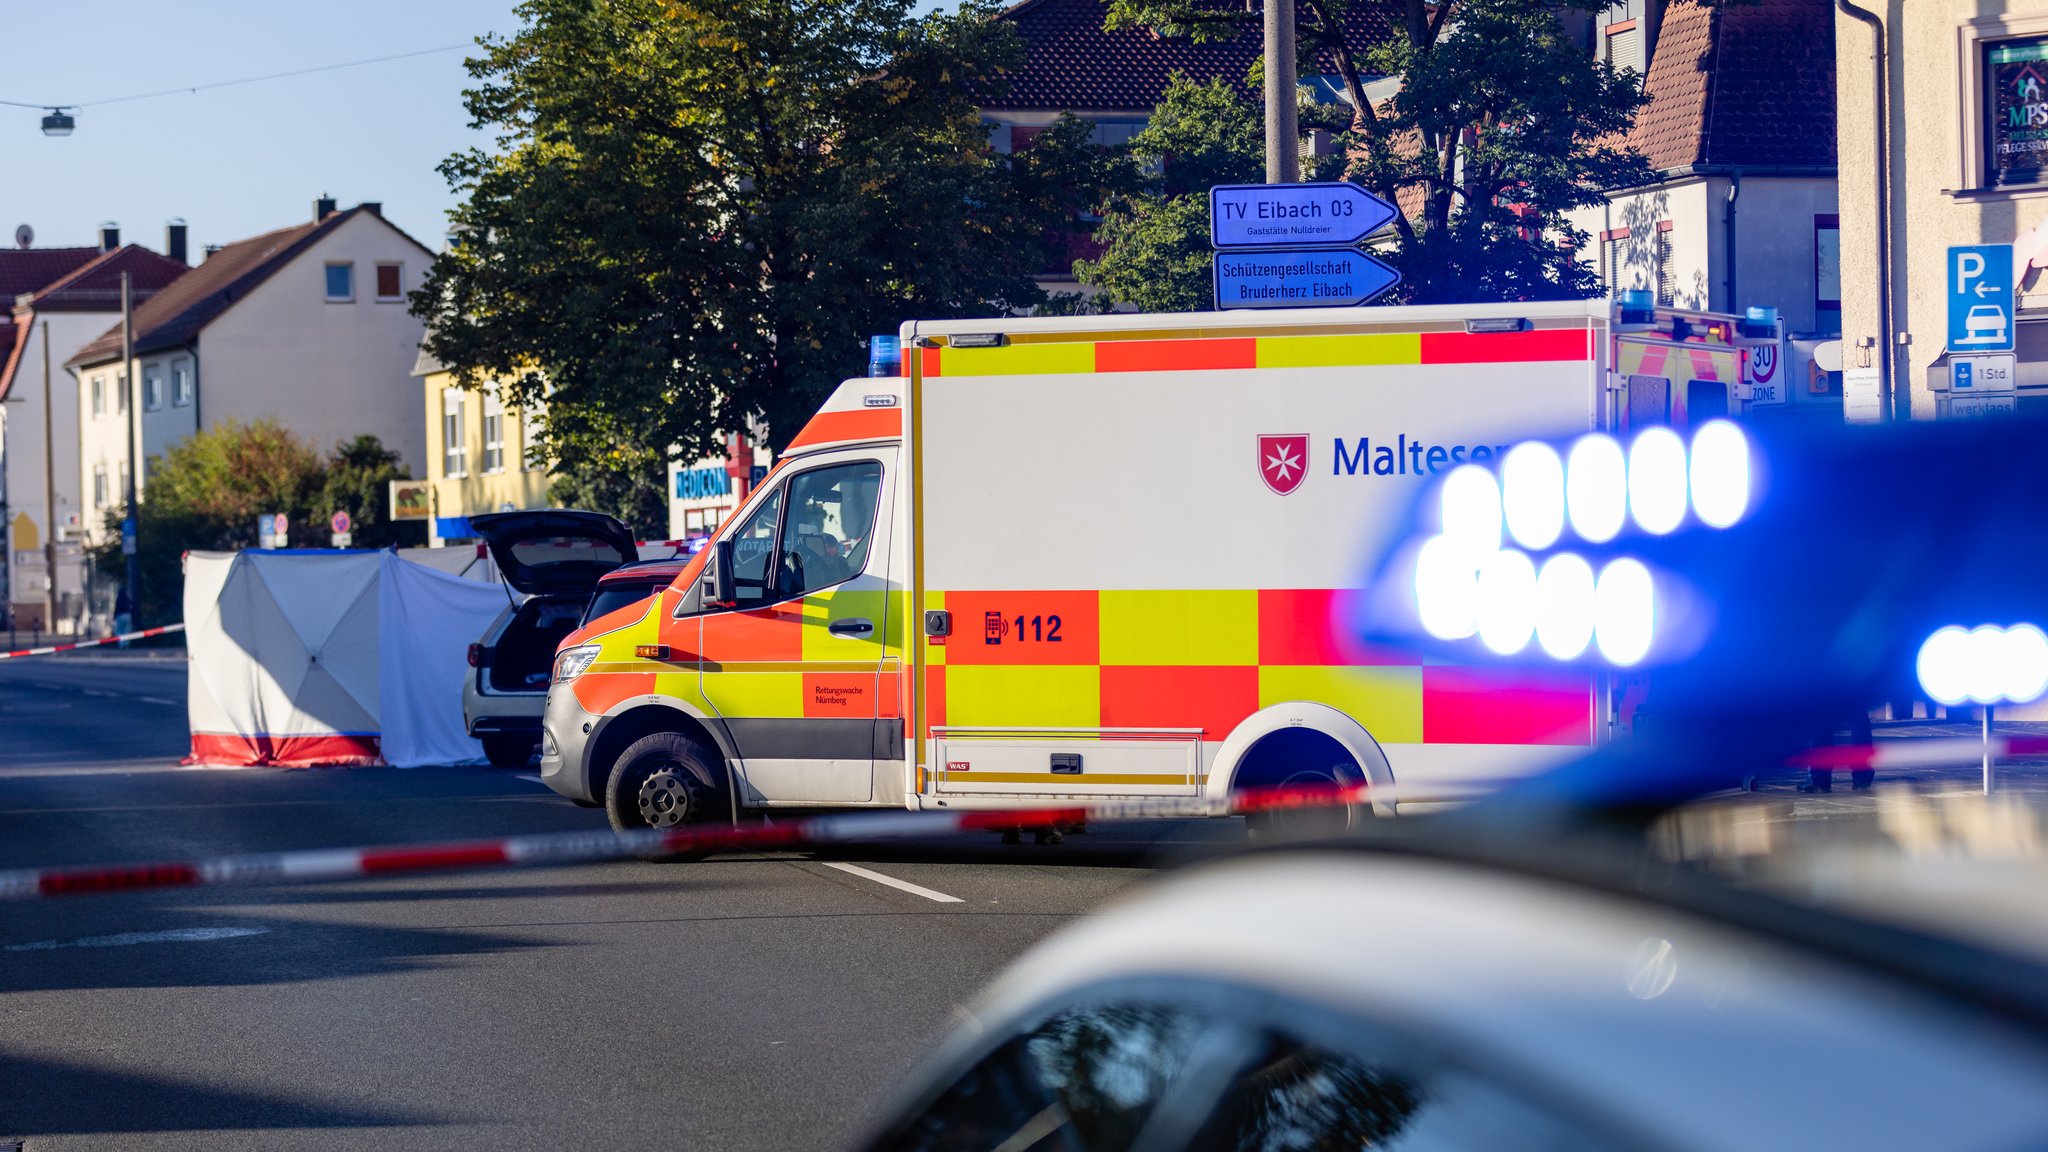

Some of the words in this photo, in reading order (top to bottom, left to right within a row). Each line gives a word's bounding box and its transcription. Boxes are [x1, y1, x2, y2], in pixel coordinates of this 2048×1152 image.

[2008, 103, 2048, 127] MPS
[1223, 202, 1247, 219] TV
[1258, 200, 1321, 218] Eibach
[1331, 200, 1353, 217] 03
[1247, 226, 1288, 236] Gaststätte
[1291, 226, 1331, 234] Nulldreier
[1223, 261, 1352, 279] Schützengesellschaft
[1957, 253, 1986, 294] P
[1240, 285, 1307, 299] Bruderherz
[1313, 283, 1352, 297] Eibach
[1753, 345, 1771, 368] 30
[1986, 368, 2008, 380] Std.
[1753, 386, 1775, 401] ZONE
[676, 467, 727, 498] MEDICON
[736, 540, 790, 554] NOTART
[1014, 615, 1062, 642] 112
[816, 686, 863, 696] Rettungswache
[816, 696, 847, 706] Nürnberg
